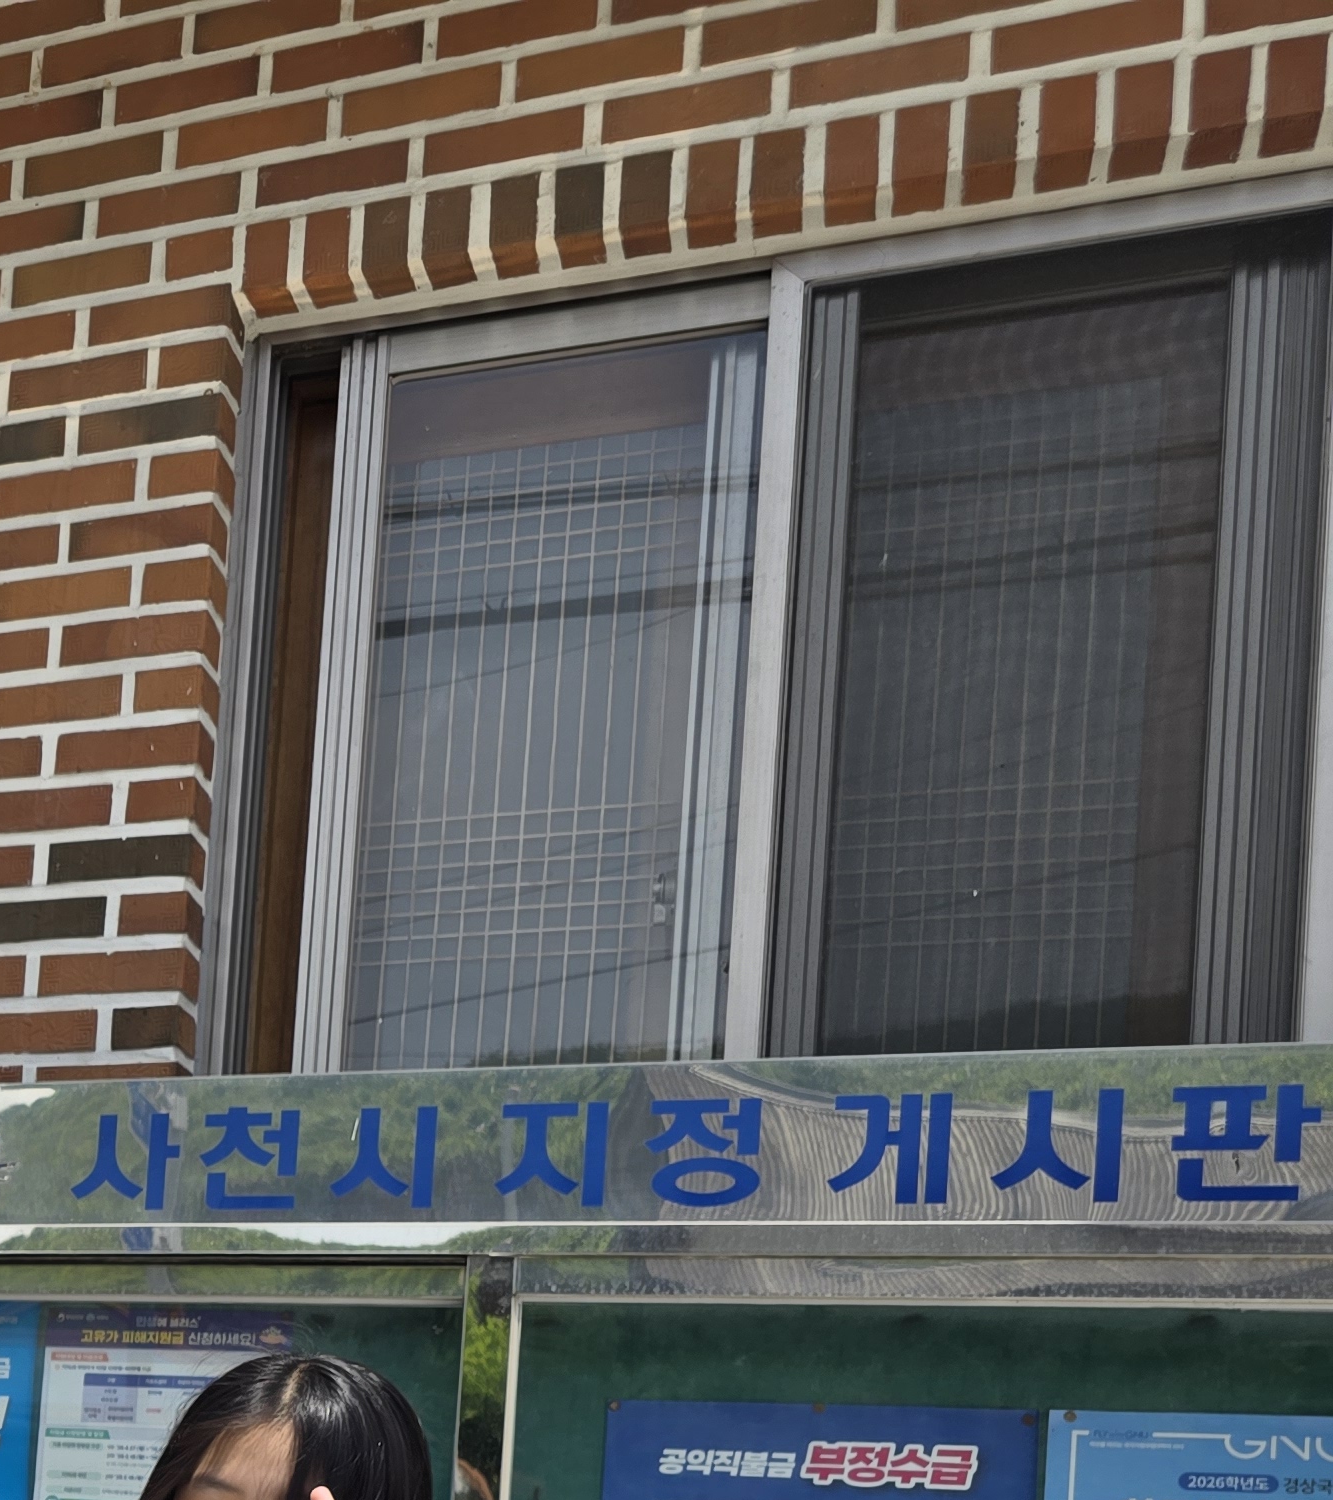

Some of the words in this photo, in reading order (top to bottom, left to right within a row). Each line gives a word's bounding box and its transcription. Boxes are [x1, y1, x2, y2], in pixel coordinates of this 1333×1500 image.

[71, 1105, 438, 1210] 사천시
[495, 1097, 763, 1207] 지정
[827, 1083, 1322, 1204] 게시판
[80, 1329, 119, 1344] 고유가
[122, 1330, 184, 1345] 피해지원금
[658, 1447, 797, 1479] 공익직불금
[800, 1441, 979, 1490] 부정수급
[1187, 1474, 1270, 1492] 2026학년도
